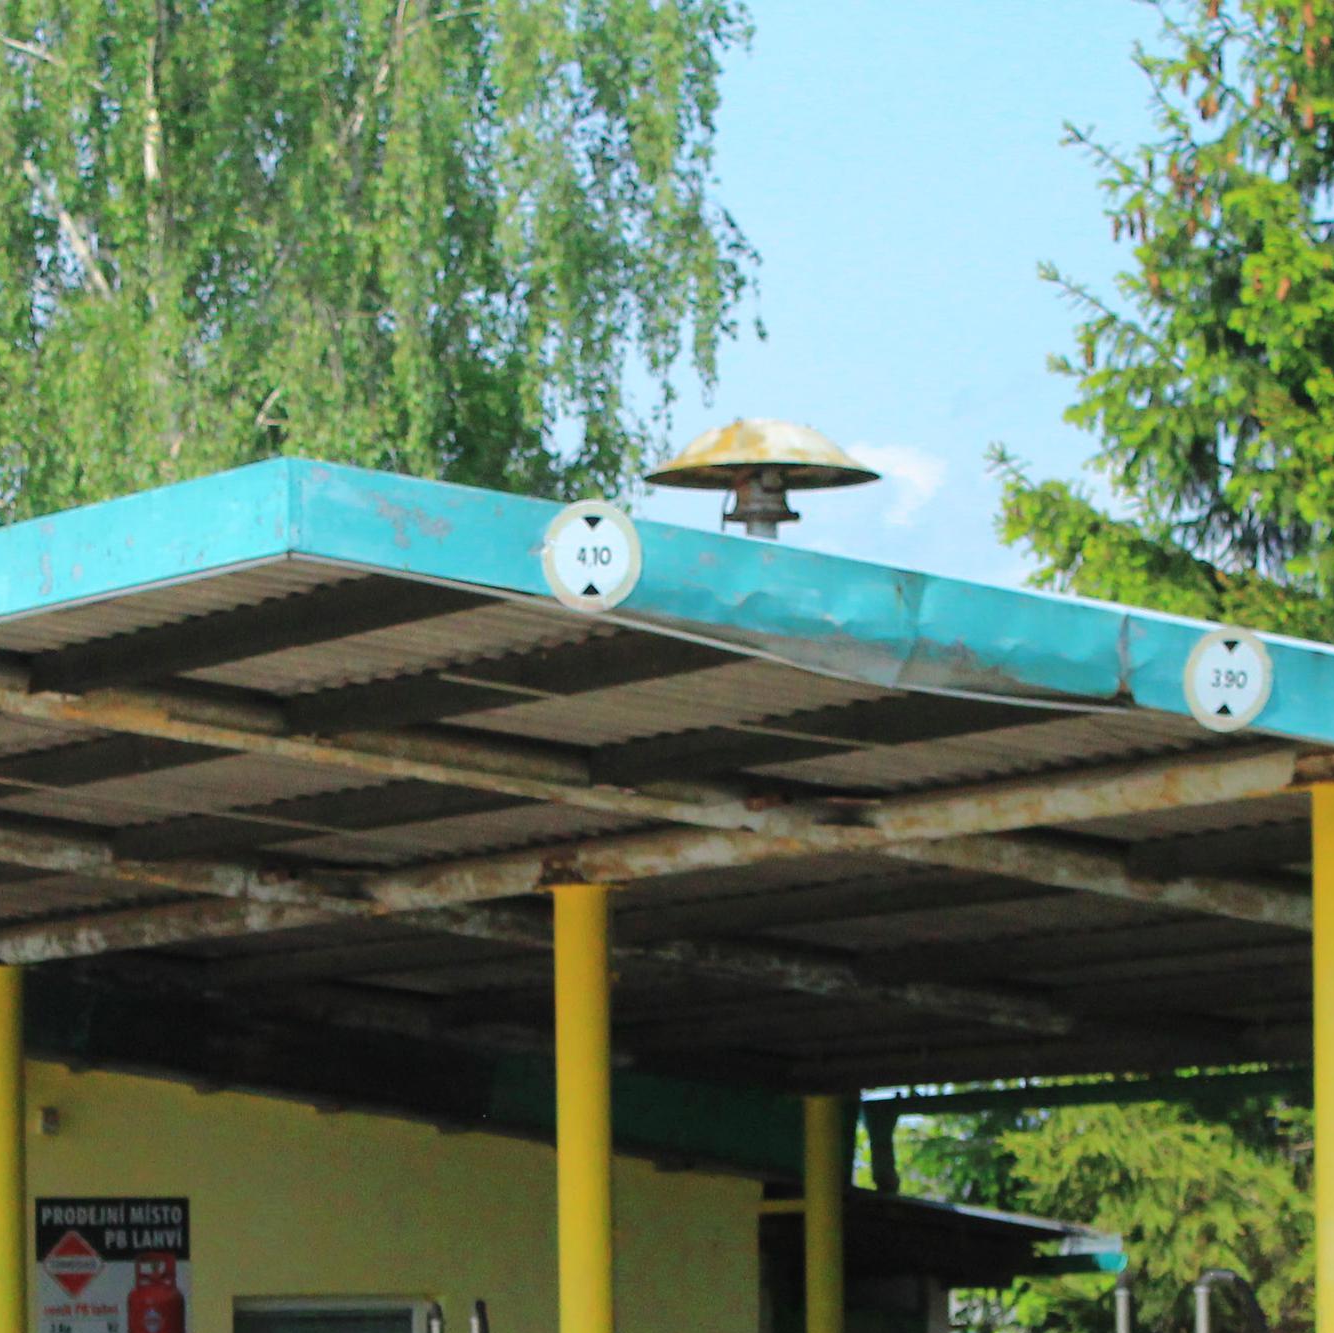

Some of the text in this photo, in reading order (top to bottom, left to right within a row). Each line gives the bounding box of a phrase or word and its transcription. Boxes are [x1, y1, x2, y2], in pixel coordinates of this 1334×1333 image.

[41, 1201, 183, 1226] PRODEJNÍ MÍSTO
[104, 1226, 183, 1249] PB LAHVÍ
